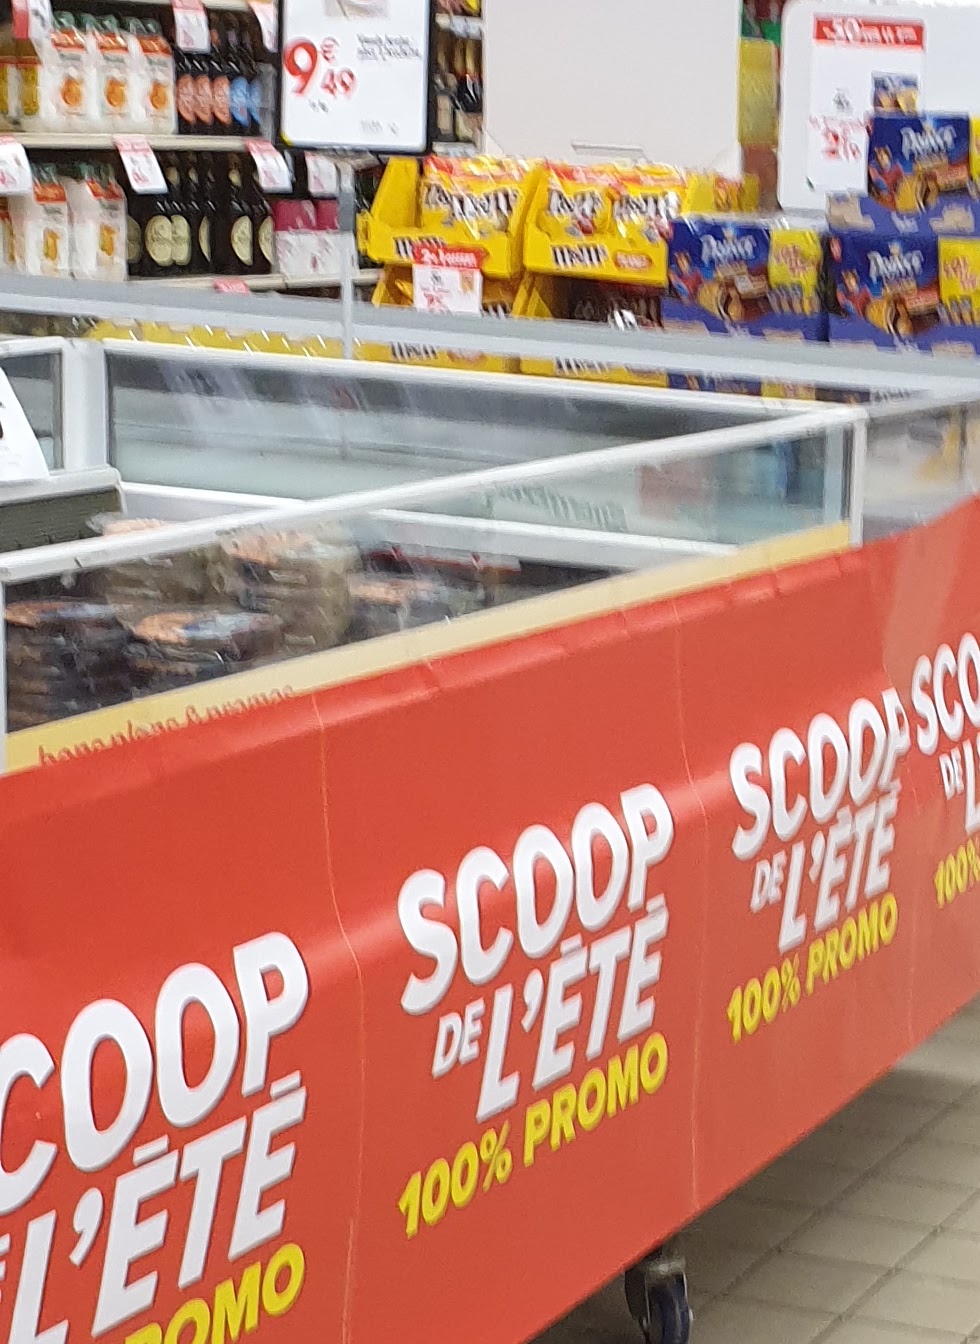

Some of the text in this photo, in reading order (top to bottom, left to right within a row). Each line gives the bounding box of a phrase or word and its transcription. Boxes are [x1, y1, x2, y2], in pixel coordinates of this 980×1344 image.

[729, 686, 910, 861] SCOOP
[398, 783, 674, 1016] SCOOP
[726, 892, 899, 1044] 100% PROMO
[750, 848, 786, 914] DE
[0, 931, 309, 1216] COOP
[431, 997, 485, 1079] DE
[398, 1032, 669, 1240] 100% PROMO
